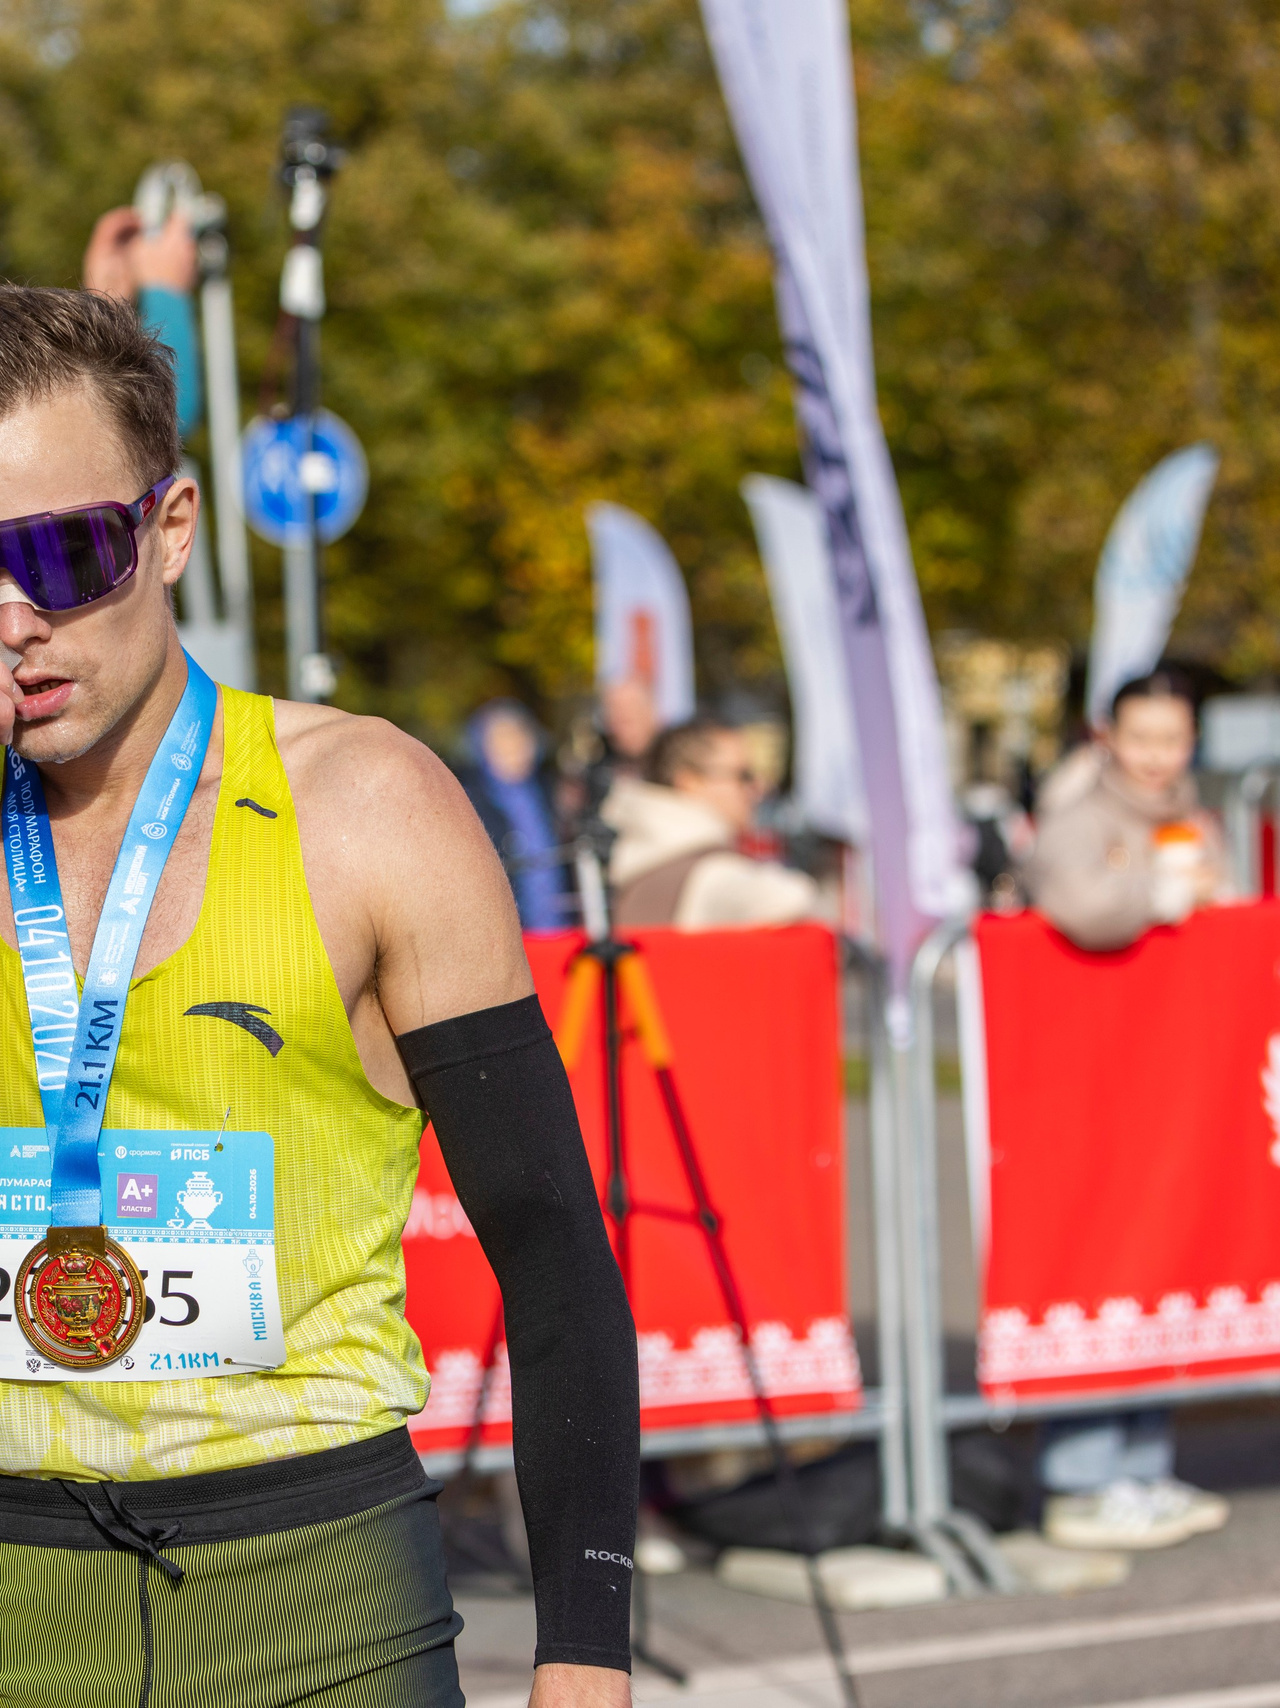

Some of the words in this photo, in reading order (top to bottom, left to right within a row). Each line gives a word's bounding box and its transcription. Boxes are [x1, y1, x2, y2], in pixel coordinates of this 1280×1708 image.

[21, 781, 46, 884] ПОЛУМАРАФОН
[8, 824, 27, 893] СТОЛИЦА»
[75, 1061, 106, 1110] 21.1
[184, 1149, 210, 1160] ПСБ
[11, 1195, 52, 1211] СТО
[121, 1205, 152, 1213] КЛАСТЕР
[249, 1168, 257, 1219] 04.10.2026
[248, 1282, 268, 1341] МОСКВА
